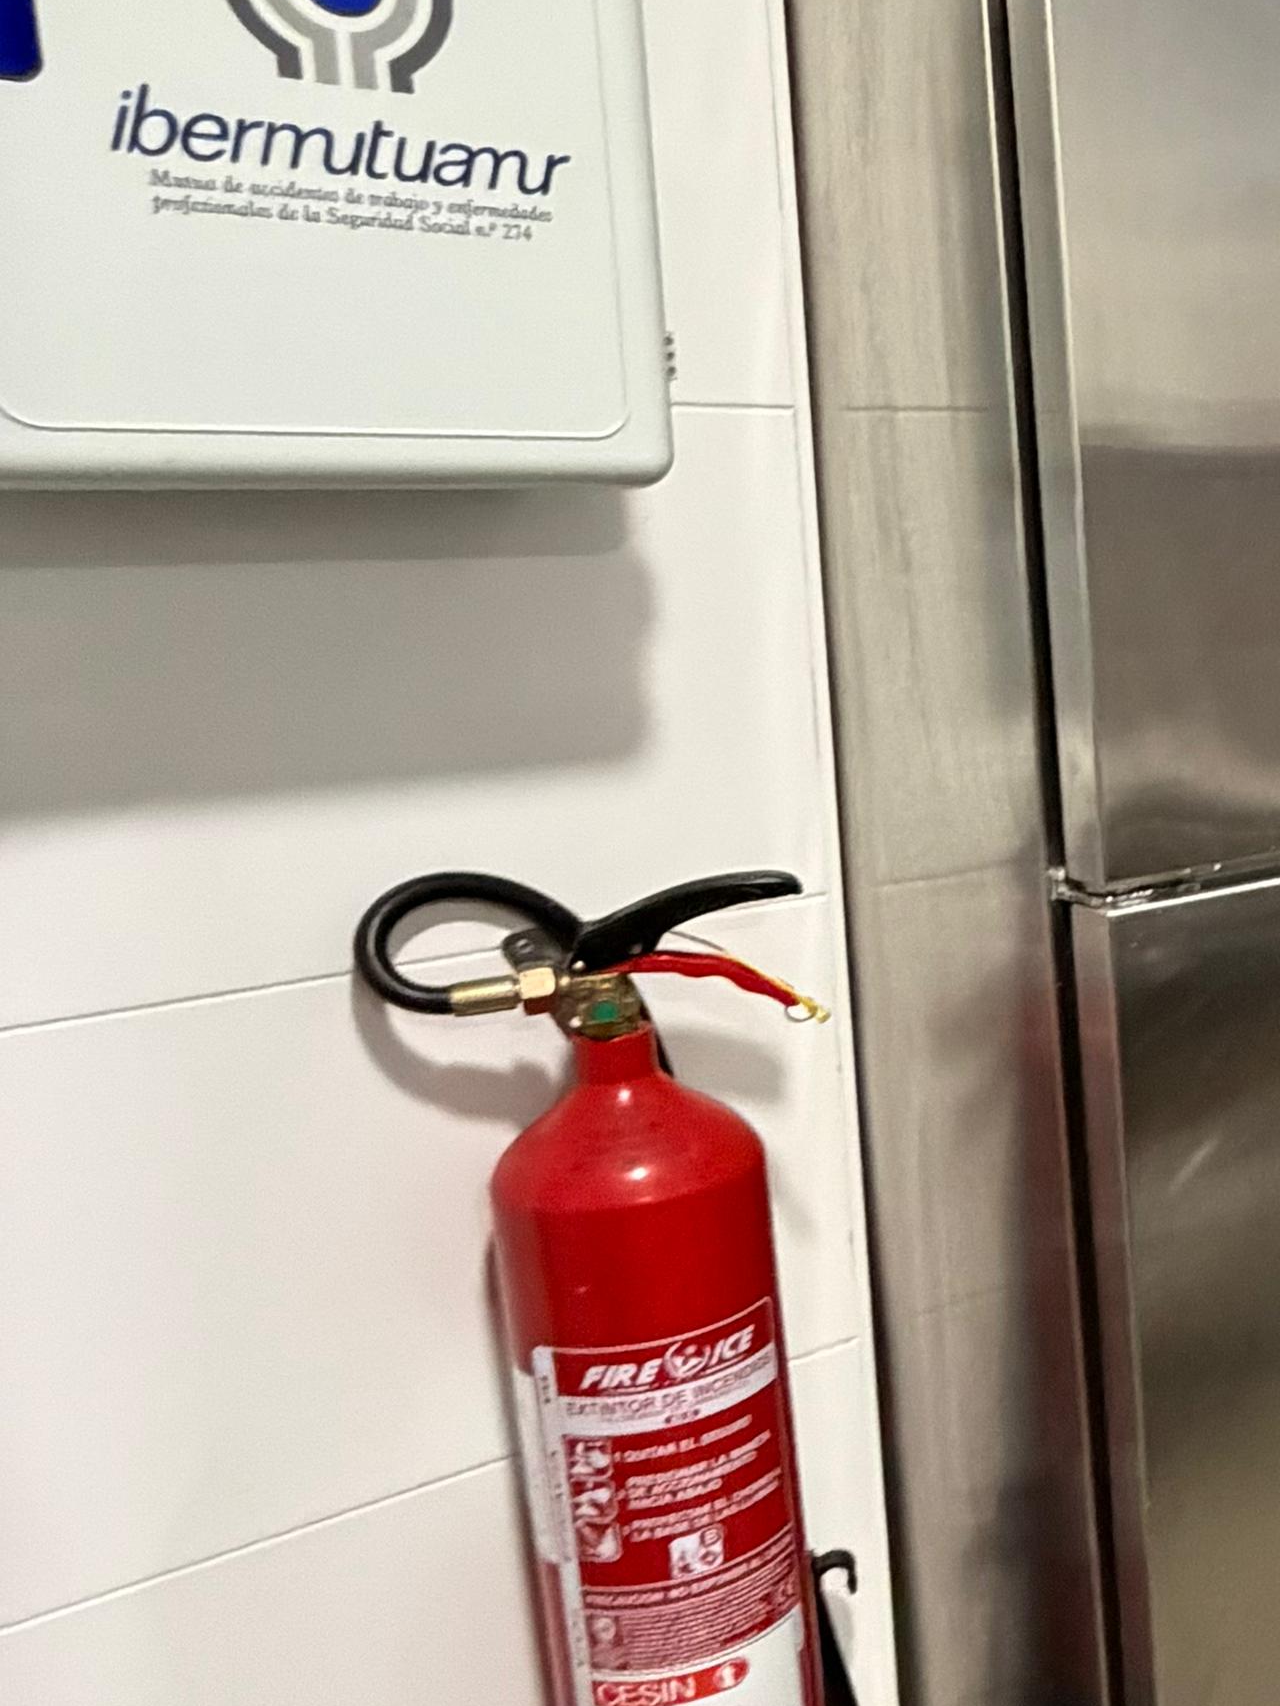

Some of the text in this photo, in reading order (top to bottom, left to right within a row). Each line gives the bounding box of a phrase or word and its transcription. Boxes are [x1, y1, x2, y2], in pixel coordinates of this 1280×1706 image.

[110, 83, 571, 196] ibermutuamur
[224, 175, 243, 193] de
[345, 188, 363, 205] de
[432, 201, 443, 215] y
[278, 203, 299, 221] de
[303, 204, 321, 223] la
[326, 207, 413, 232] Seguridad
[419, 216, 471, 236] Social
[579, 1358, 663, 1391] FIRE
[709, 1324, 756, 1365] ICE
[661, 1389, 688, 1408] DE
